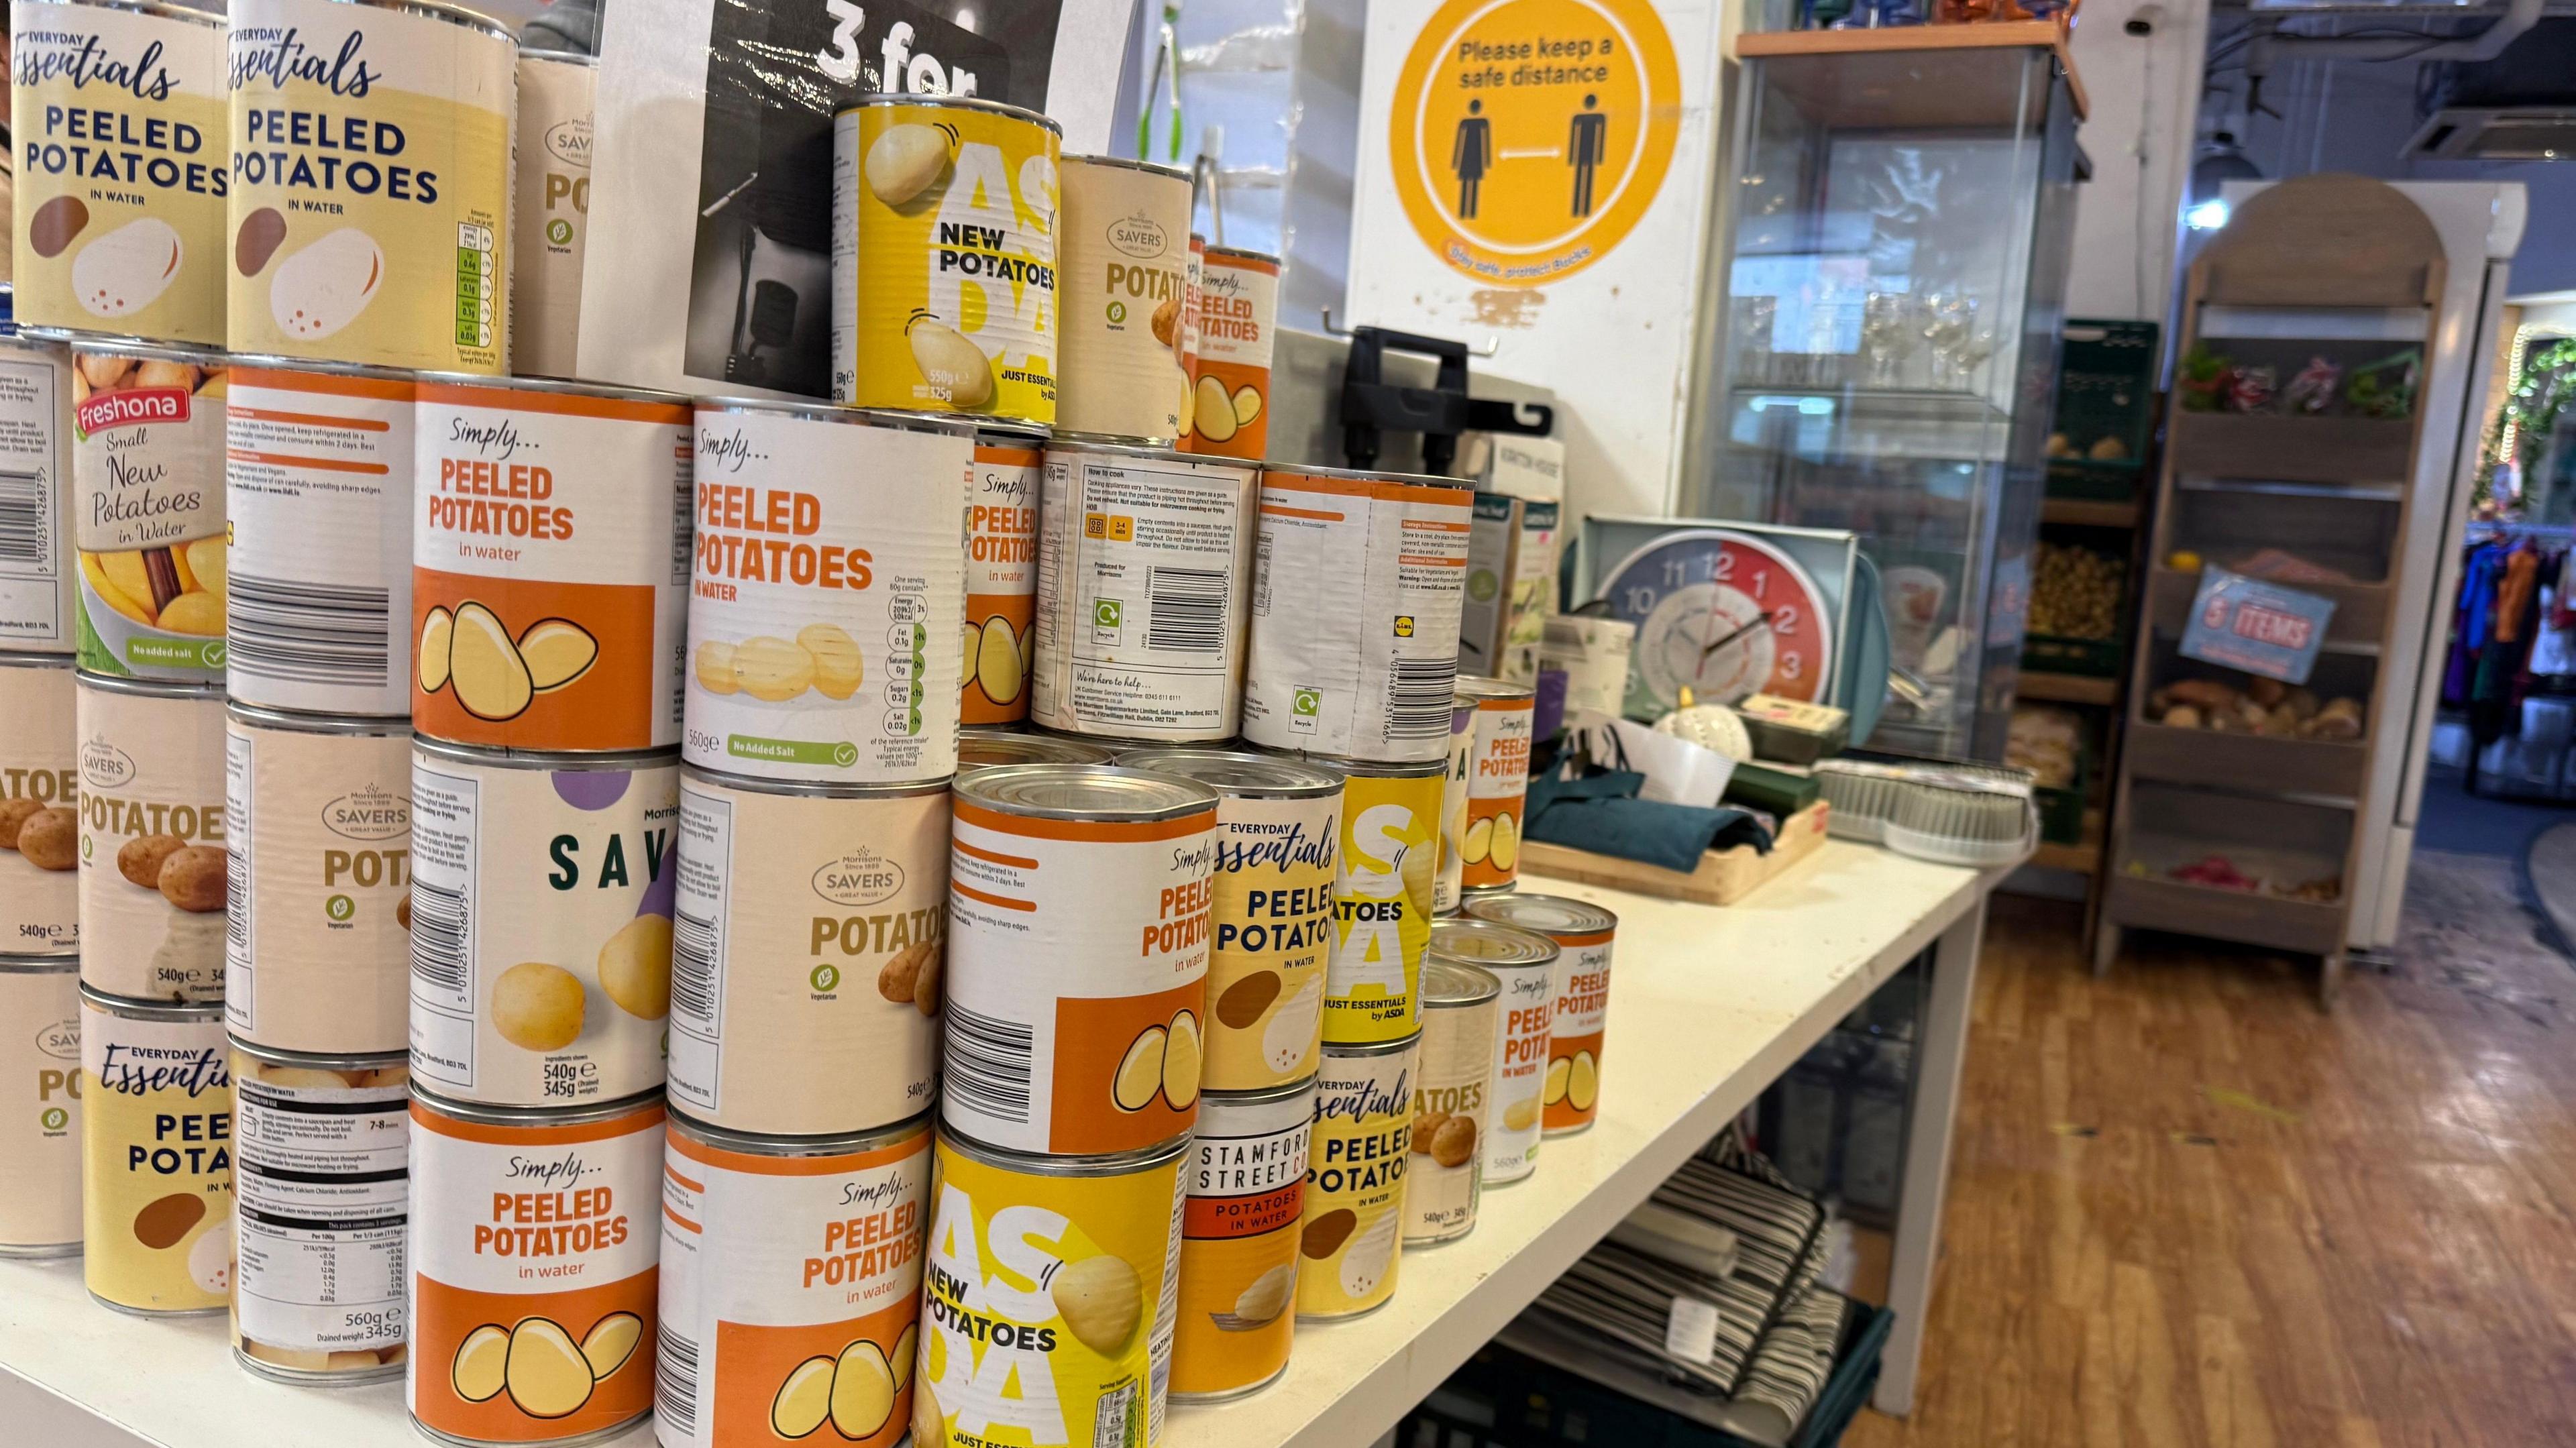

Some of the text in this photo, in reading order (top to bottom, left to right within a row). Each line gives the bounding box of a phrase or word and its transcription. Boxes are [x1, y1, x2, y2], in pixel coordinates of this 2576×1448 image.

[29, 31, 83, 45] EVERYDAY
[235, 27, 282, 42] EVERYDAY
[816, 0, 977, 97] 3 for
[1458, 38, 1613, 62] Please keep a
[1460, 64, 1607, 89] safe distance
[46, 105, 201, 154] PEELED
[248, 110, 406, 156] PEELED
[27, 142, 227, 197] POTATOES
[233, 152, 437, 205] POTATOES
[91, 188, 145, 205] IN WATER
[288, 199, 343, 216] IN WATER
[940, 221, 1006, 252] NEW
[1116, 230, 1161, 247] SAVERS
[939, 249, 1055, 292] POTATOES
[1202, 294, 1252, 319] EELED
[1001, 370, 1026, 381] JUST
[930, 386, 952, 402] 325g
[80, 394, 178, 431] Freshona
[106, 428, 148, 453] Small
[449, 417, 540, 461] Simply...
[700, 428, 769, 472] Simply...
[106, 455, 167, 491] New
[440, 458, 553, 502] PEELED
[983, 474, 1034, 506] Simply...
[93, 488, 201, 528] Potatoes
[429, 494, 574, 541] POTATOES
[698, 482, 821, 536] PEELED
[973, 505, 1035, 533] PEELED
[119, 523, 186, 544] in Water
[459, 542, 522, 562] in water
[970, 536, 1038, 563] OTATOES
[695, 534, 873, 591] POTATOES
[989, 569, 1024, 581] in water
[1663, 550, 1768, 599] 11 12 1
[695, 579, 737, 602] IN WATER
[895, 597, 913, 605] Energy
[1626, 587, 1800, 634] 10 2
[133, 643, 192, 659] No added salt
[895, 638, 908, 647] 0.1g
[896, 667, 905, 675] 0g
[1780, 651, 1803, 679] 3
[890, 685, 908, 693] Sugars
[1097, 674, 1113, 685] here
[1115, 678, 1122, 686] to
[892, 693, 906, 703] 0.2g
[888, 722, 907, 731] 0.02g
[733, 740, 795, 757] No Added Salt
[84, 754, 124, 776] SAVERS
[81, 790, 225, 840] POTATOE
[336, 810, 407, 824] SAVERS
[1230, 823, 1291, 834] EVERYDAY
[826, 873, 893, 889] SAVERS
[19, 924, 46, 940] 540g
[1142, 910, 1210, 956] POTATO
[158, 967, 186, 983] 540g
[1175, 960, 1183, 972] in
[1284, 956, 1315, 969] IN WATER
[1351, 997, 1406, 1009] ESSENTIALS
[1372, 1009, 1405, 1021] by ASDA
[131, 1047, 199, 1060] EVERYDAY
[101, 1043, 229, 1098] Essenti
[544, 1064, 576, 1080] 540g
[544, 1080, 575, 1097] 345g
[1414, 1082, 1482, 1117] ATOES
[156, 1114, 229, 1141] PEE
[370, 1121, 384, 1130] 7-8
[1201, 1129, 1309, 1166] STAMFORD
[1327, 1123, 1411, 1162] PEELED
[129, 1146, 229, 1174] POTA
[505, 1152, 602, 1188] Simply...
[207, 1183, 219, 1192] IN
[1199, 1162, 1287, 1189] STREET
[839, 1171, 913, 1209] Simply...
[1369, 1193, 1389, 1204] WATER
[492, 1186, 612, 1223] PEELED
[1215, 1190, 1297, 1218] POTATOES
[824, 1201, 916, 1253] PEELED
[1231, 1211, 1287, 1231] IN WATER
[474, 1215, 629, 1258] POTATOES
[518, 1260, 586, 1279] in water
[802, 1227, 921, 1288] POTATOES
[846, 1278, 897, 1304] in water
[928, 1258, 968, 1303] NEW
[345, 1313, 382, 1327] 560g
[926, 1293, 1057, 1352] POTATOES
[317, 1324, 401, 1342] Drained weight 345g
